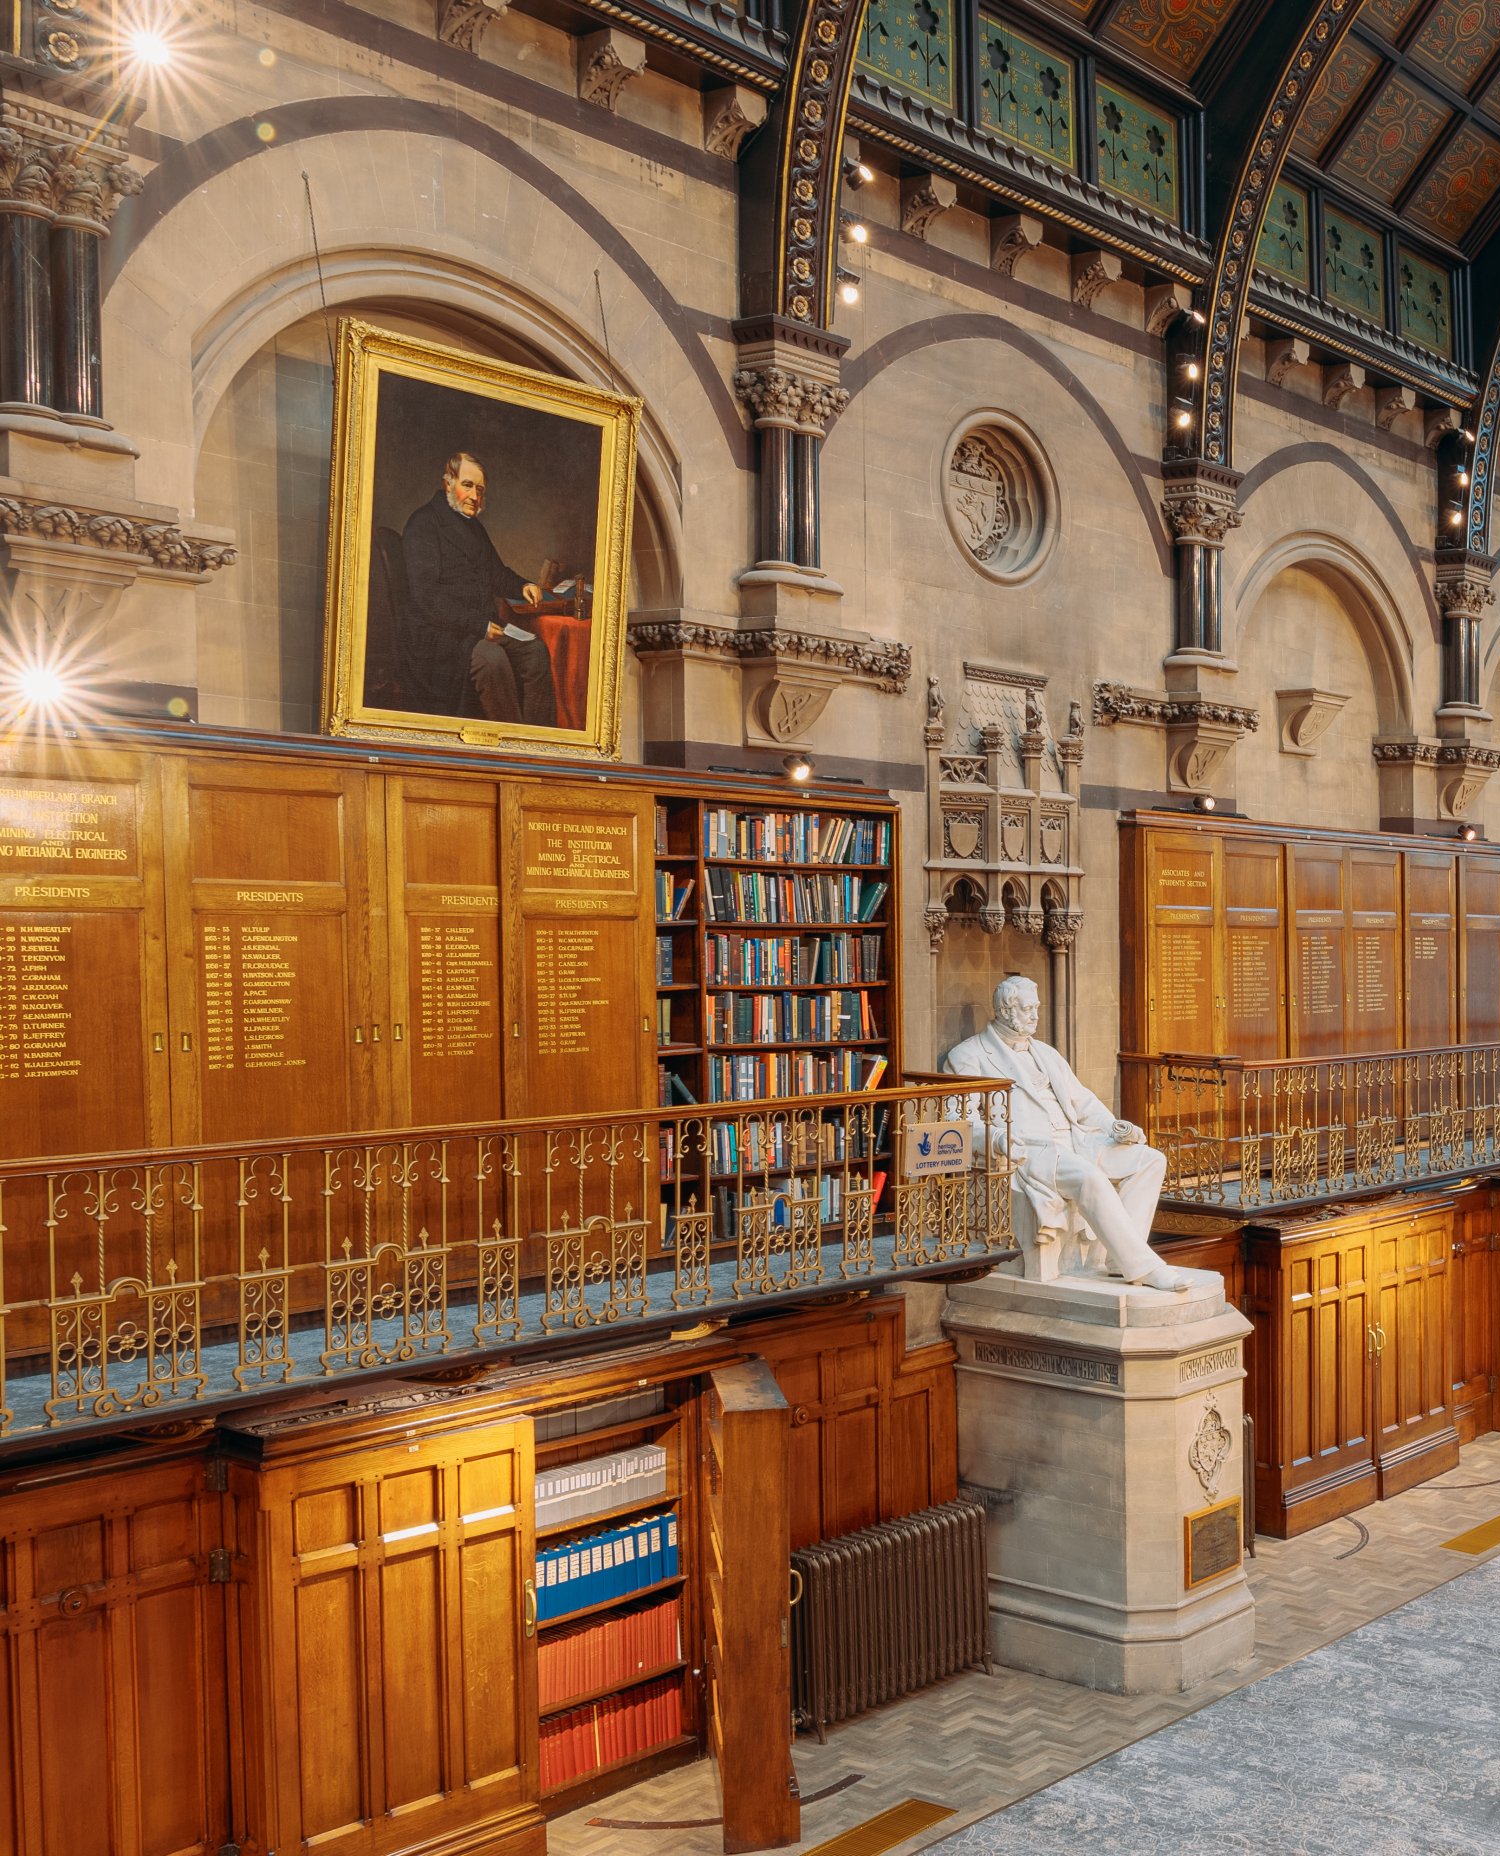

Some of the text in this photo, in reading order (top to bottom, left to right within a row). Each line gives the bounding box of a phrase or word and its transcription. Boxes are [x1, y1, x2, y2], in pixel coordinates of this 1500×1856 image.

[81, 794, 117, 805] BRANCH
[528, 822, 551, 831] NORTH
[564, 824, 594, 833] ENGLAND
[596, 826, 627, 835] BRANCH
[45, 830, 108, 842] ELECTRICAL
[548, 839, 612, 850] THE INSTITUTION
[16, 846, 73, 859] MECHANICAL
[76, 848, 127, 860] ENGINEERS
[539, 853, 621, 864] MINING ELECTRICAL
[527, 867, 630, 879] MINING MECHANICAL ENGINEERS
[15, 886, 90, 898] PRESIDENTS
[237, 891, 304, 902] PRESIDENTS
[442, 896, 499, 906] PRESIDENTS
[556, 900, 608, 909] PRESIDENTS
[916, 1159, 962, 1169] LOTTERY FUNDED
[977, 1342, 1003, 1363] FIRST
[1006, 1346, 1061, 1375] PRESIDENT
[1061, 1358, 1071, 1376] OF
[1075, 1360, 1093, 1379] THE
